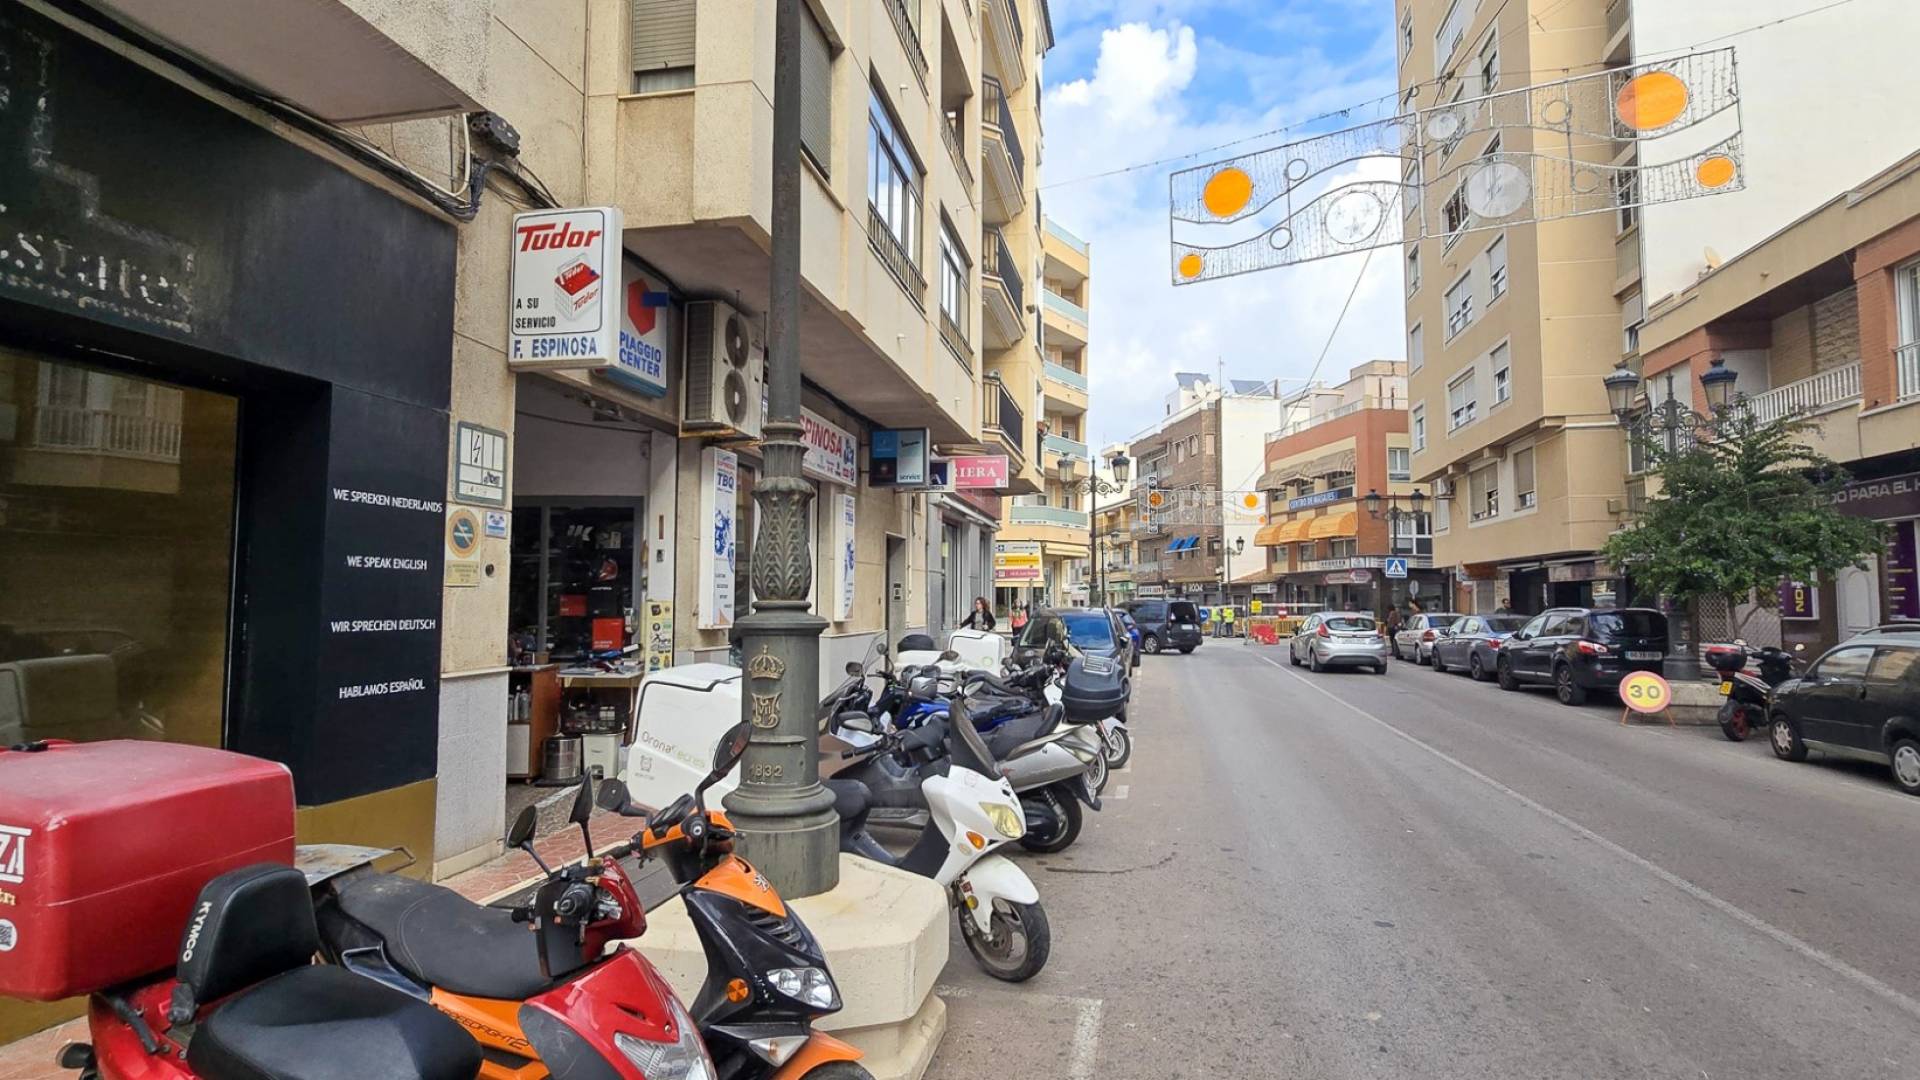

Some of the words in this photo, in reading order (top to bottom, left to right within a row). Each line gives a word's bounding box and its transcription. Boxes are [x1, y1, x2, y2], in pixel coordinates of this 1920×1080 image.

[517, 222, 602, 252] Tudor
[516, 298, 522, 309] A
[527, 298, 539, 309] SU
[515, 316, 556, 329] SERVICIO
[514, 340, 523, 359] F.
[532, 337, 597, 358] ESPINOSA
[619, 331, 662, 364] PIAGGIO
[619, 348, 660, 378] CENTER
[717, 472, 735, 490] TBQ
[1850, 484, 1890, 501] PARA
[1893, 481, 1911, 494] EL
[333, 488, 350, 501] WE
[350, 490, 390, 506] SPREKEN
[392, 497, 442, 512] NEDERLANDS
[347, 555, 363, 568] WE
[364, 557, 391, 569] SPEAK
[393, 558, 427, 570] ENGLISH
[331, 621, 350, 633] WIR
[351, 620, 397, 632] SPRECHEN
[399, 619, 436, 631] DEUTSCH
[339, 684, 389, 699] HABLAMOS
[390, 678, 425, 694] ESPAÑOL
[1630, 684, 1660, 700] 30
[183, 901, 213, 963] KYMCO
